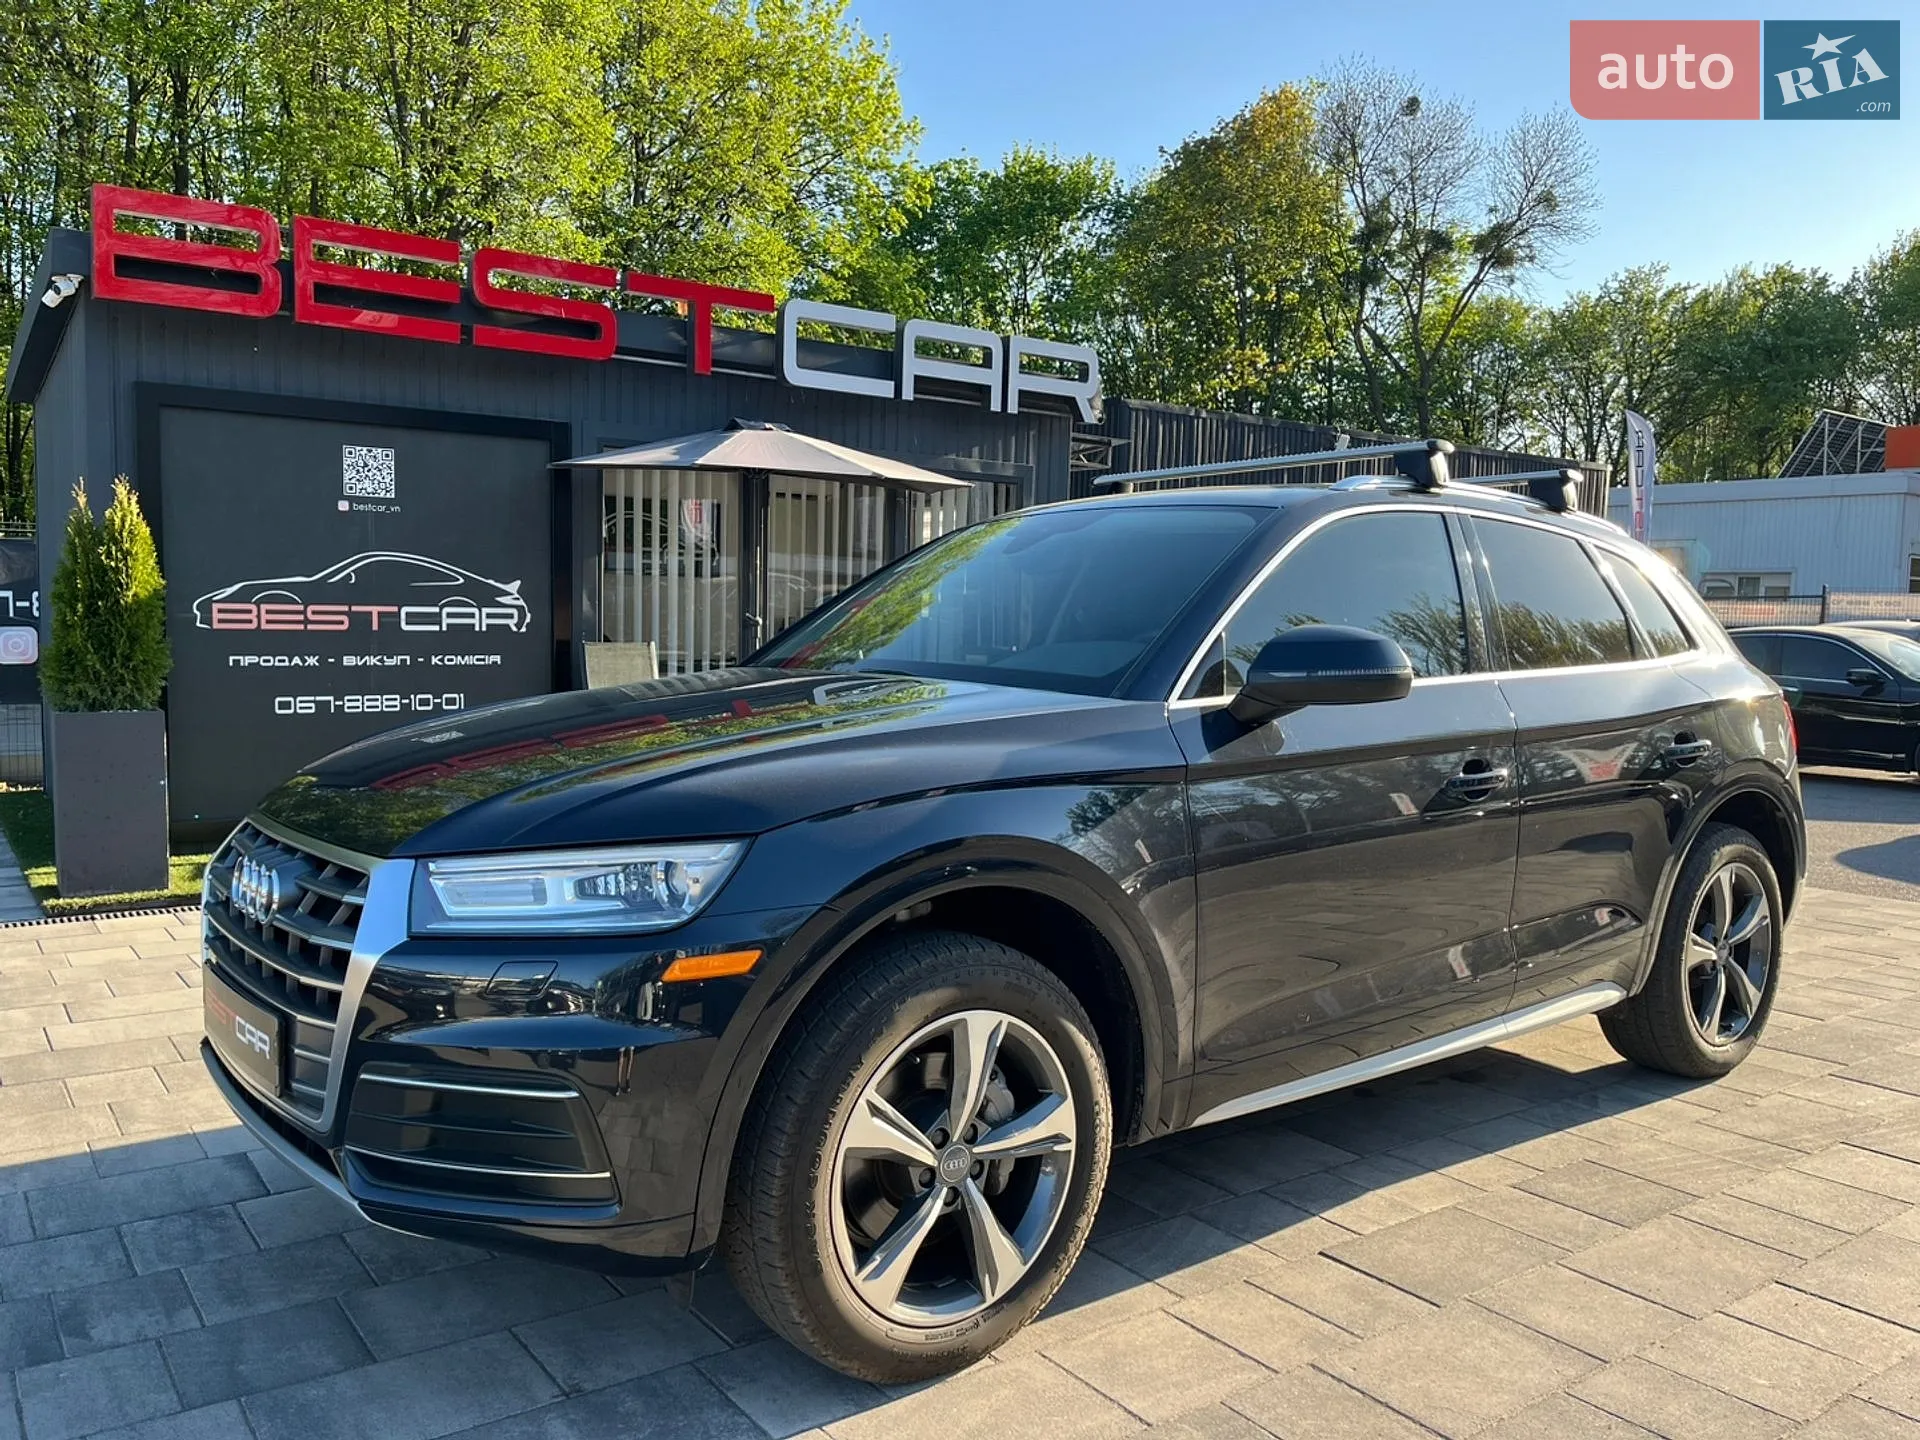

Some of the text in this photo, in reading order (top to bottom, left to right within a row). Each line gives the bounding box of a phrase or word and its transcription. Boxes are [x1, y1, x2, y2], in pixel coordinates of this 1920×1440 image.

[352, 503, 401, 513] bestcar_vn
[229, 655, 320, 667] ПРОДАЖ
[343, 655, 411, 666] ВИКУП
[431, 655, 502, 665] КОМІСІЯ
[274, 693, 465, 714] 067-888-10-01
